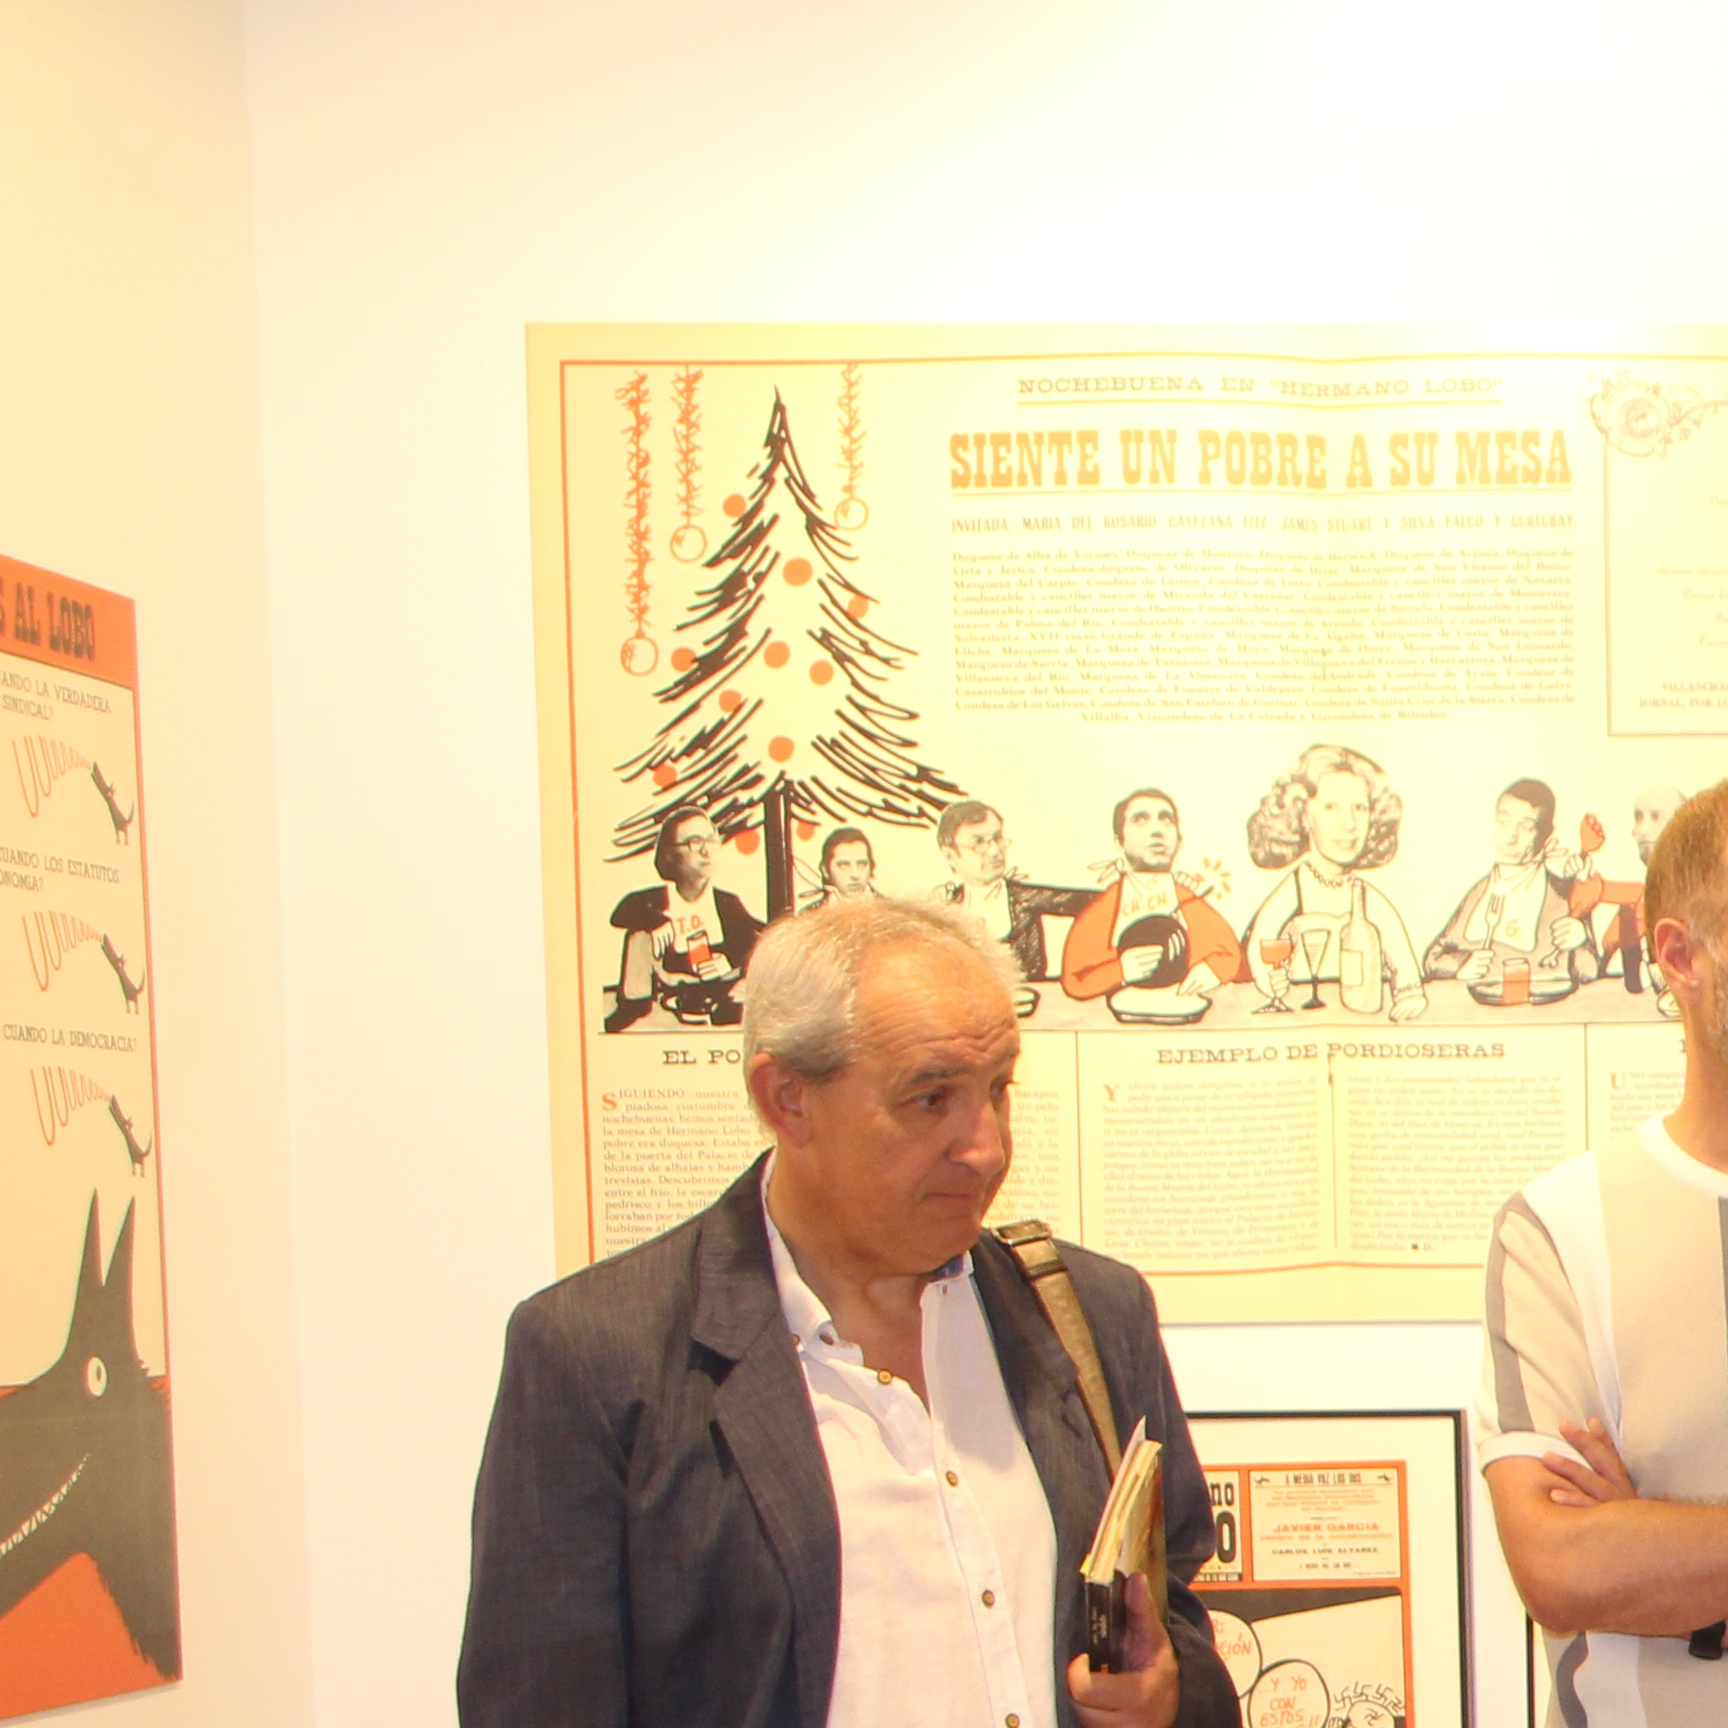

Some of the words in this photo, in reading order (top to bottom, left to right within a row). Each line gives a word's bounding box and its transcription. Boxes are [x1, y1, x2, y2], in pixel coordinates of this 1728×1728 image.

[1017, 377, 1203, 394] NOCHEBUENA
[1219, 378, 1256, 392] EN
[949, 430, 1101, 490] SIENTE
[1119, 429, 1180, 486] UN
[1197, 430, 1327, 490] POBRE
[1346, 432, 1374, 488] A
[1388, 431, 1447, 487] SU
[1454, 430, 1573, 486] MESA
[14, 582, 41, 645] AL
[47, 592, 96, 660] LOBO
[0, 671, 32, 692] ANDO
[36, 680, 50, 697] LA
[54, 684, 112, 714] VERDADERA
[43, 855, 64, 873] LOS
[67, 859, 120, 884] ESTATUTOS
[3, 1024, 48, 1044] CUANDO
[51, 1028, 66, 1046] LA
[663, 1051, 696, 1064] EL
[1156, 1045, 1279, 1065] EJEMPLO
[1286, 1043, 1319, 1062] DE
[1327, 1041, 1506, 1060] PORDIOSERAS
[1272, 1524, 1322, 1534] JAVIER
[1326, 1522, 1380, 1532] GARCIA
[1270, 1695, 1296, 1710] CON
[1260, 1707, 1305, 1727] ESTOS
